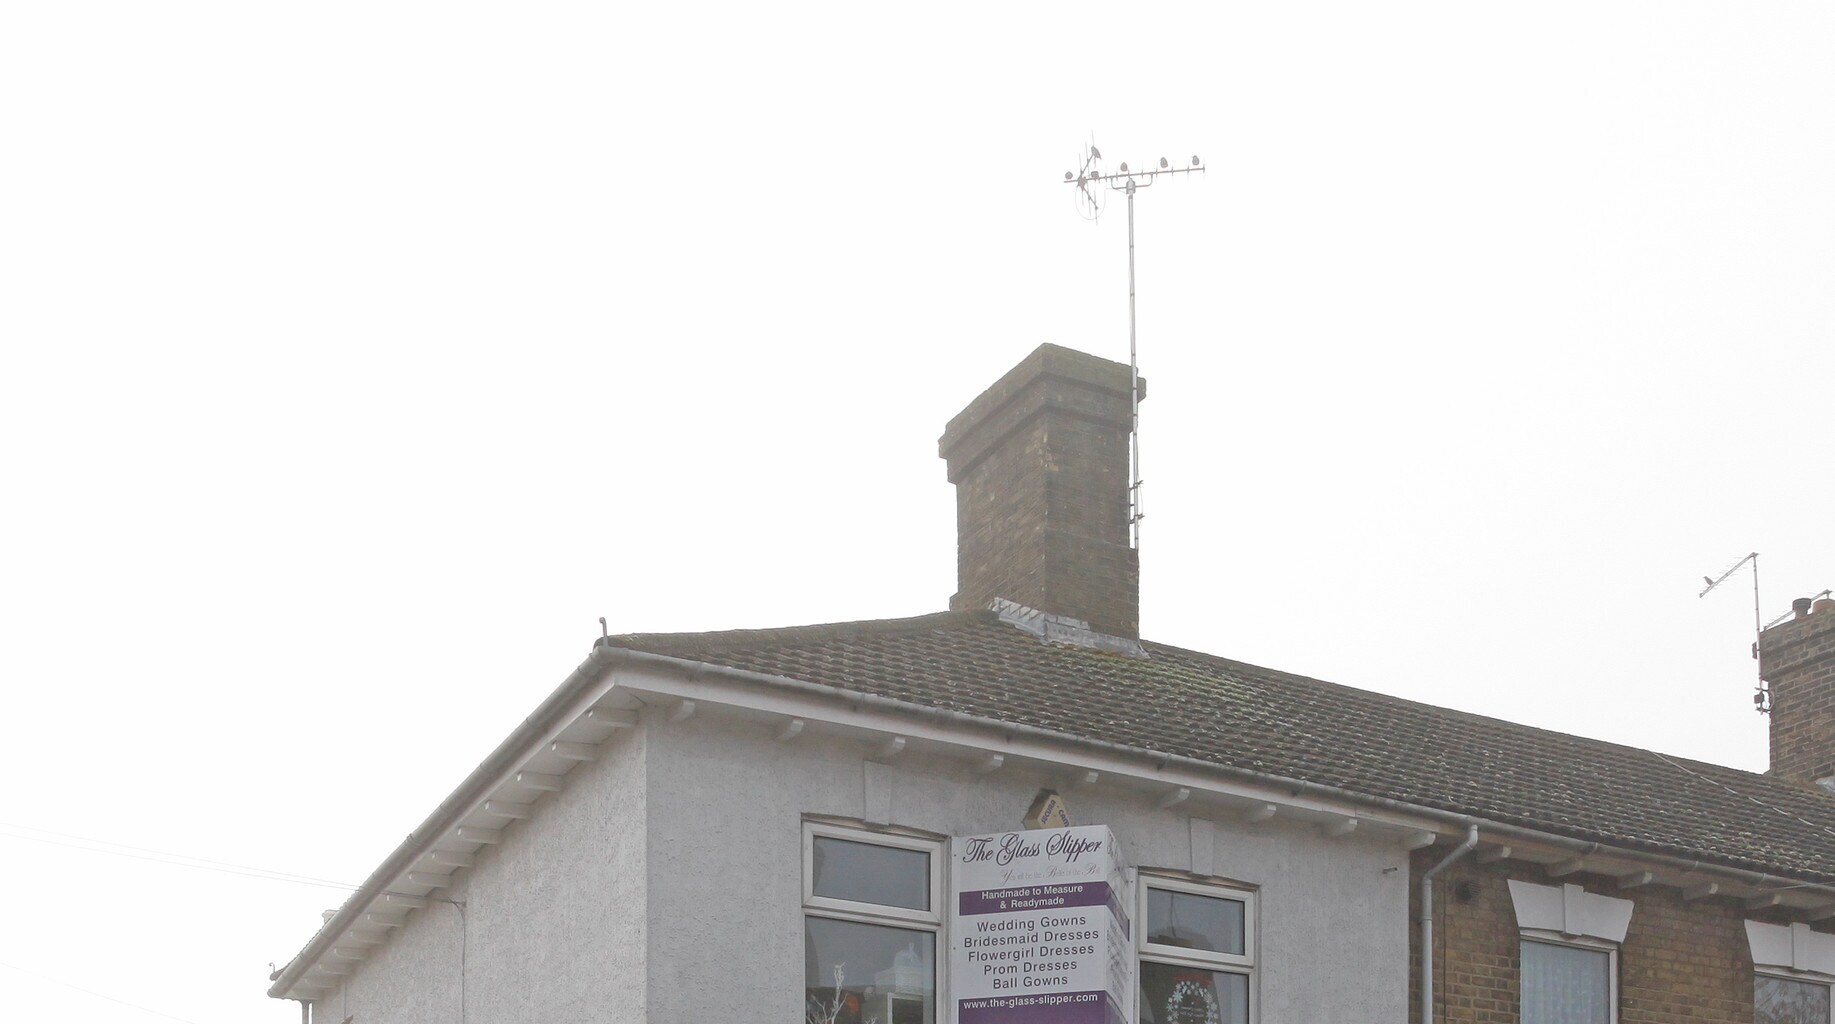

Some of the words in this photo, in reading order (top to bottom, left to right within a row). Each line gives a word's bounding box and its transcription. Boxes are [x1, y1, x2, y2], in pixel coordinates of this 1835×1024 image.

[962, 837, 994, 863] The
[996, 832, 1041, 866] Glass
[1045, 830, 1103, 863] Slipper
[981, 889, 1030, 900] Handmade
[1032, 888, 1042, 896] to
[1043, 885, 1083, 895] Measure
[999, 901, 1007, 909] &
[1011, 897, 1065, 910] Readymade
[977, 919, 1035, 932] Wedding
[1040, 916, 1086, 928] Gowns
[964, 932, 1039, 948] Bridesmaid
[1044, 929, 1099, 942] Dresses
[968, 947, 1035, 963] Flowergirl
[1040, 945, 1095, 957] Dresses
[984, 964, 1018, 976] Prom
[1023, 960, 1078, 972] Dresses
[993, 977, 1018, 990] Ball
[1023, 975, 1068, 988] Gowns
[963, 993, 1099, 1009] www.the-glass-slipper.com
